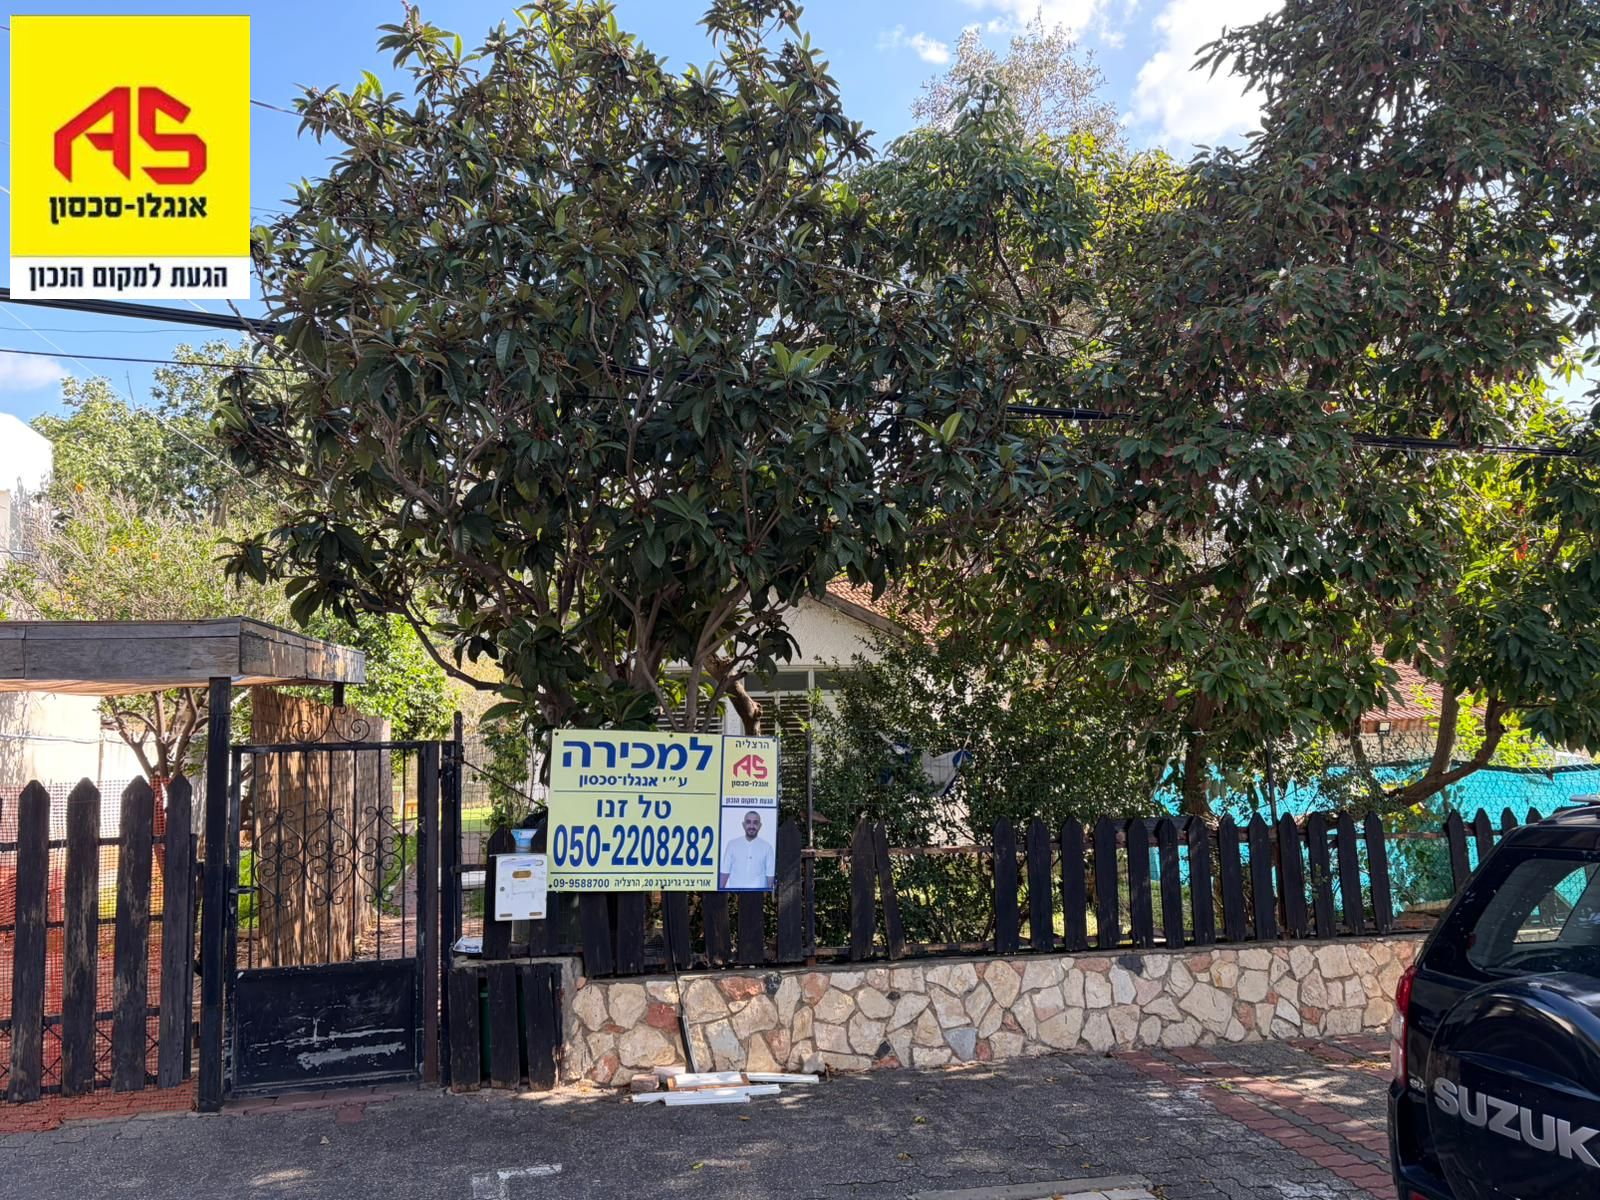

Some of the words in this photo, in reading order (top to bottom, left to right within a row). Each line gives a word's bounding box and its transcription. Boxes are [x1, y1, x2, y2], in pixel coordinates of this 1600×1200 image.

[735, 739, 770, 749] הרצליה
[562, 736, 713, 771] למכירה
[733, 754, 768, 779] AS
[579, 773, 658, 788] אנגלו-סכסון
[731, 780, 769, 788] אנגלו-סכסון
[596, 798, 628, 818] זנו
[638, 794, 672, 819] טל
[553, 824, 714, 867] 050-2208282
[553, 878, 610, 888] 09-9588700
[614, 877, 641, 887] הרצליה
[655, 878, 682, 887] גרינברג
[682, 878, 695, 887] צבי
[697, 878, 711, 887] אורי
